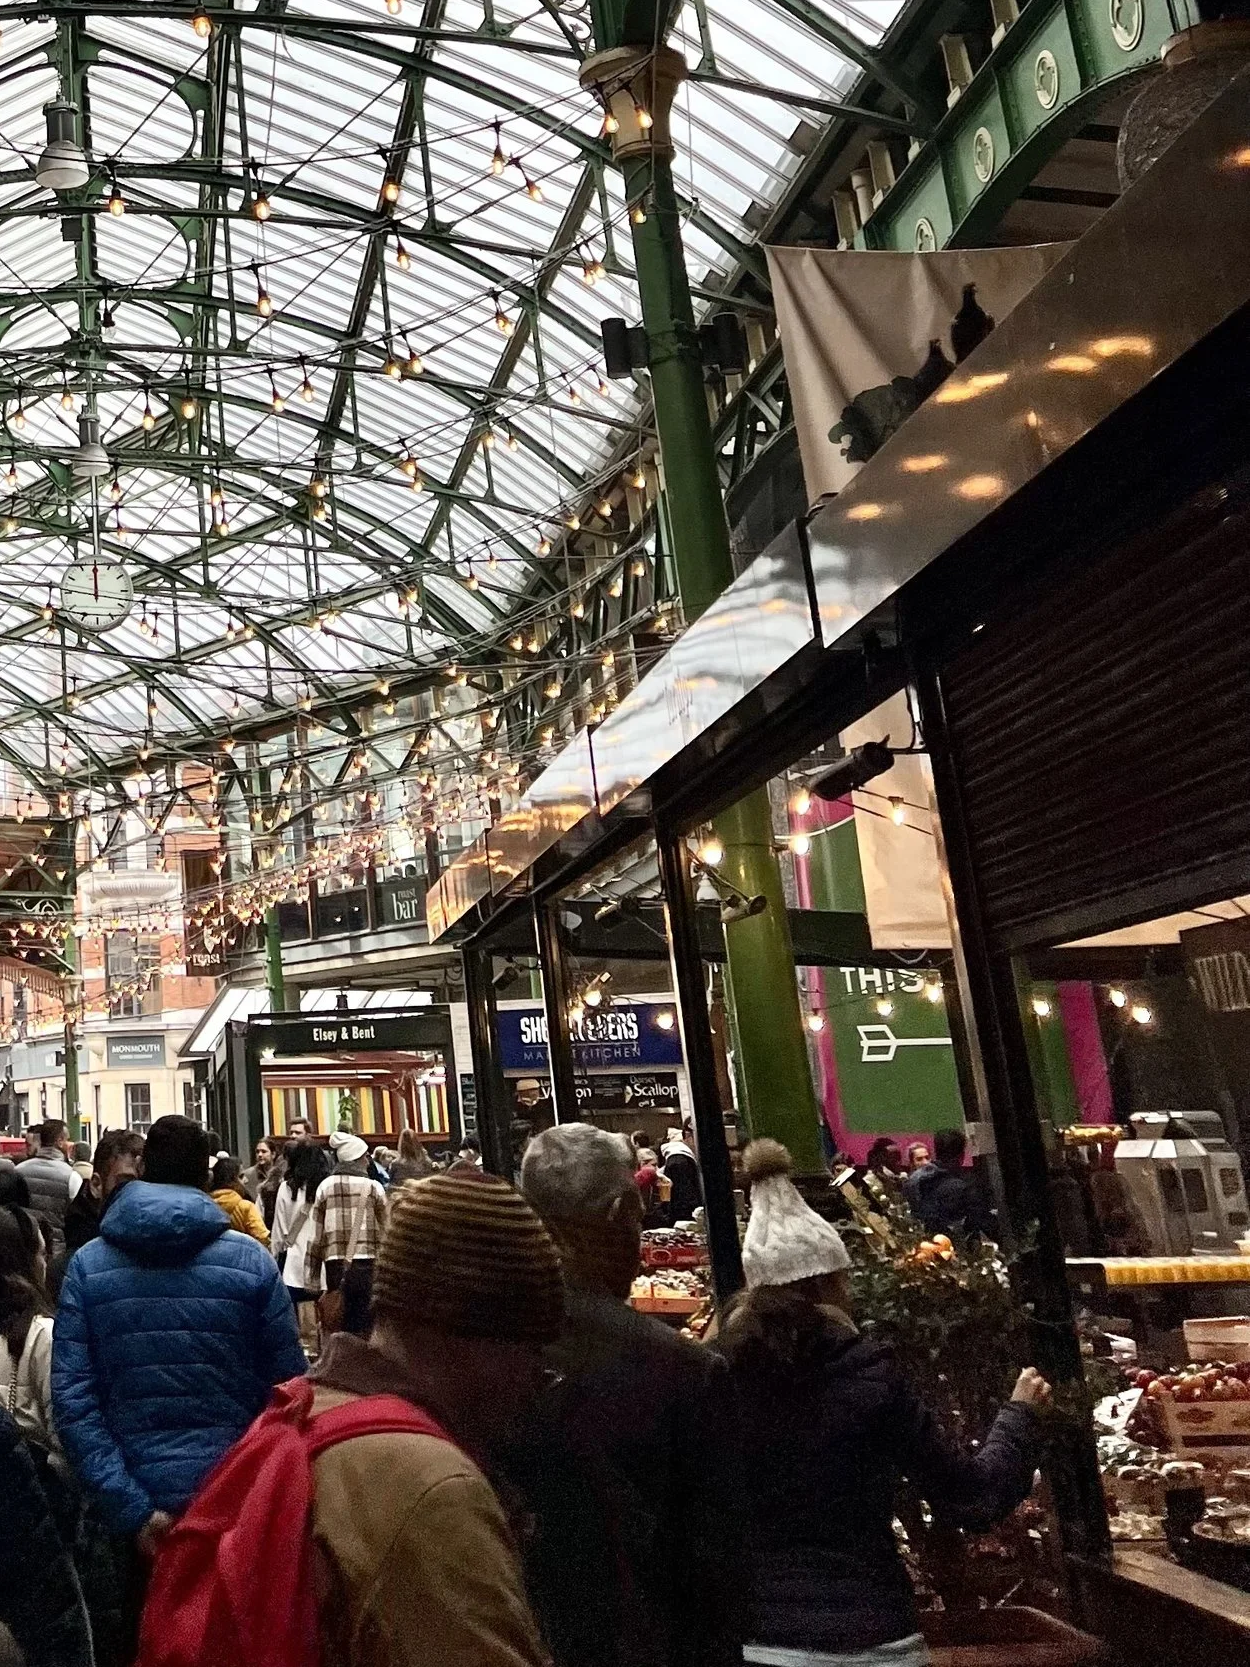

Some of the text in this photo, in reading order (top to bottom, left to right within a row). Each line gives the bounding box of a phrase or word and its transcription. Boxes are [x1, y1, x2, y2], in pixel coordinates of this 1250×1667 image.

[391, 892, 418, 921] bar
[312, 1025, 376, 1043] Elsey & Bent
[111, 1043, 161, 1054] MONMOUTH
